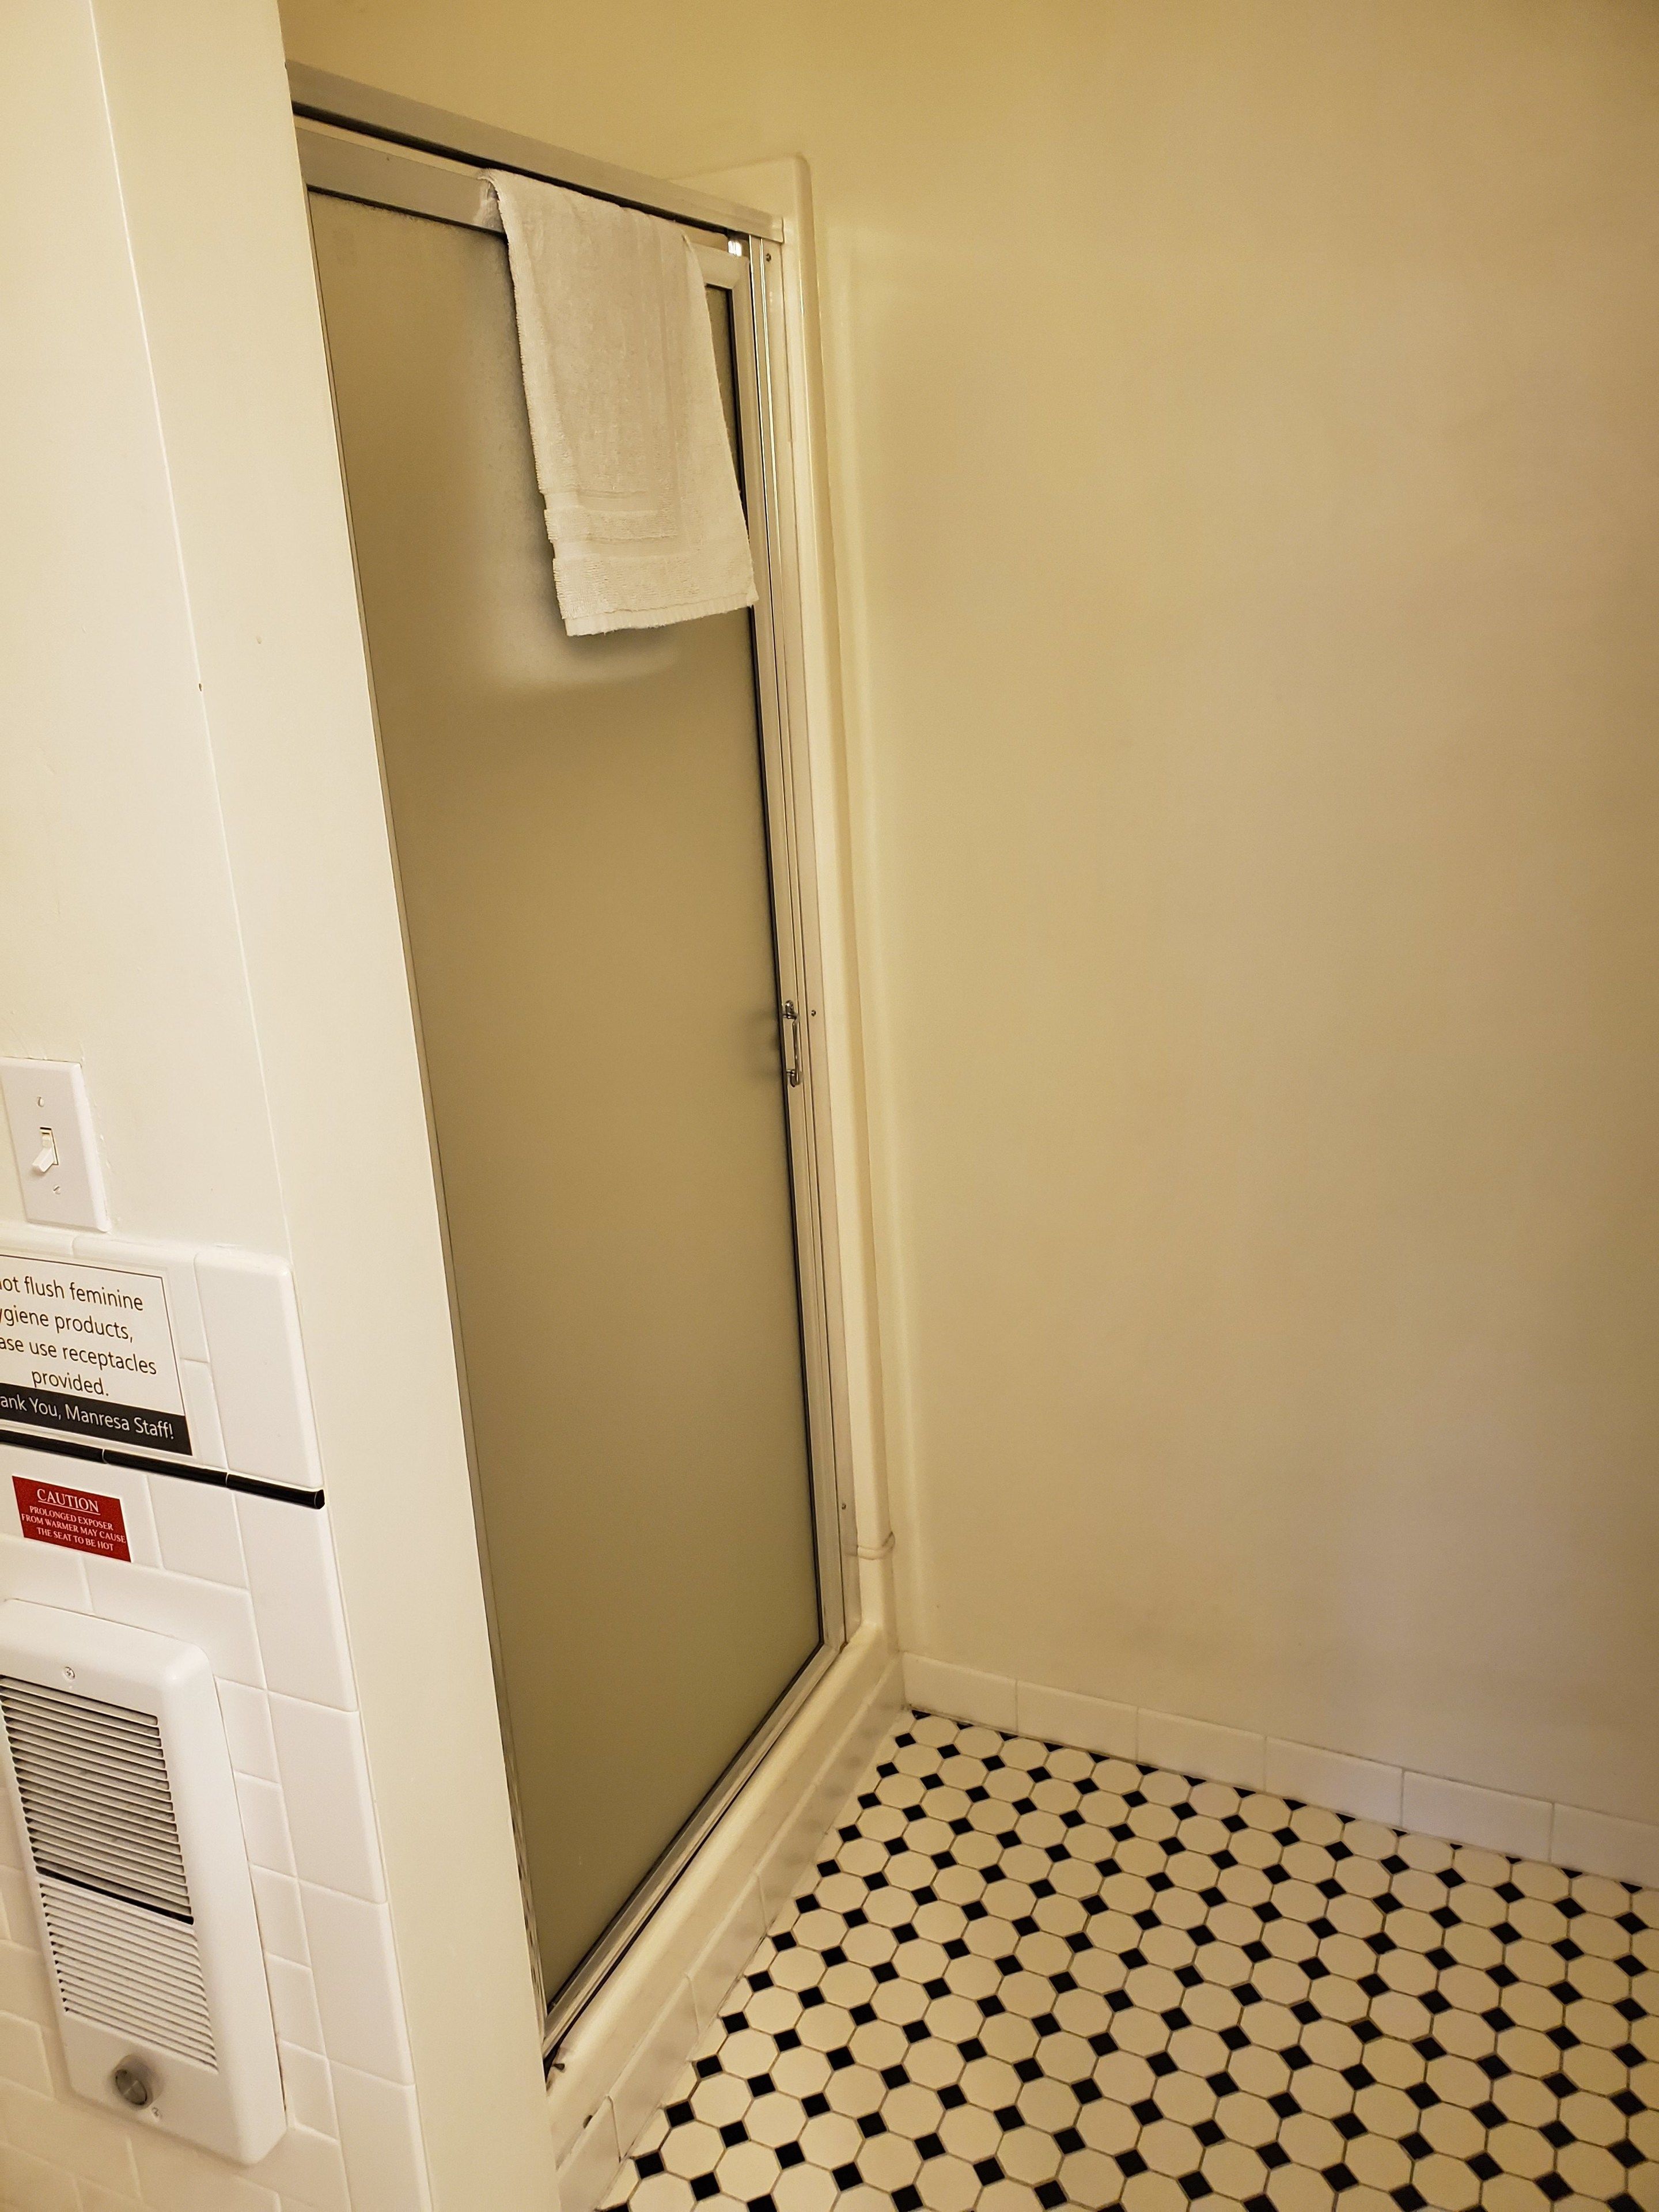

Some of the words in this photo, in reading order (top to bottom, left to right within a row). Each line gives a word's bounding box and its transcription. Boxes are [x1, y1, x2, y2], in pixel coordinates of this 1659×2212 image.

[0, 1277, 20, 1293] ot
[24, 1276, 65, 1299] flush
[70, 1282, 143, 1311] feminine
[55, 1316, 133, 1343] products,
[29, 1342, 57, 1358] use
[62, 1346, 157, 1375] receptacles
[32, 1370, 109, 1396] provided.
[29, 1397, 62, 1421] You,
[65, 1404, 130, 1431] Manresa
[135, 1416, 175, 1440] Staff!
[37, 1488, 99, 1513] CAUTION
[21, 1513, 44, 1525] FROM
[45, 1518, 79, 1533] WARMER
[81, 1527, 97, 1536] MAY
[99, 1531, 126, 1543] CAUSE
[29, 1505, 77, 1522] PROLONGED
[78, 1516, 113, 1531] EXPOSER
[36, 1527, 52, 1537] THE
[54, 1531, 71, 1541] SEAT
[73, 1535, 85, 1544] TO
[86, 1537, 96, 1547] BE
[97, 1541, 114, 1551] HOT
